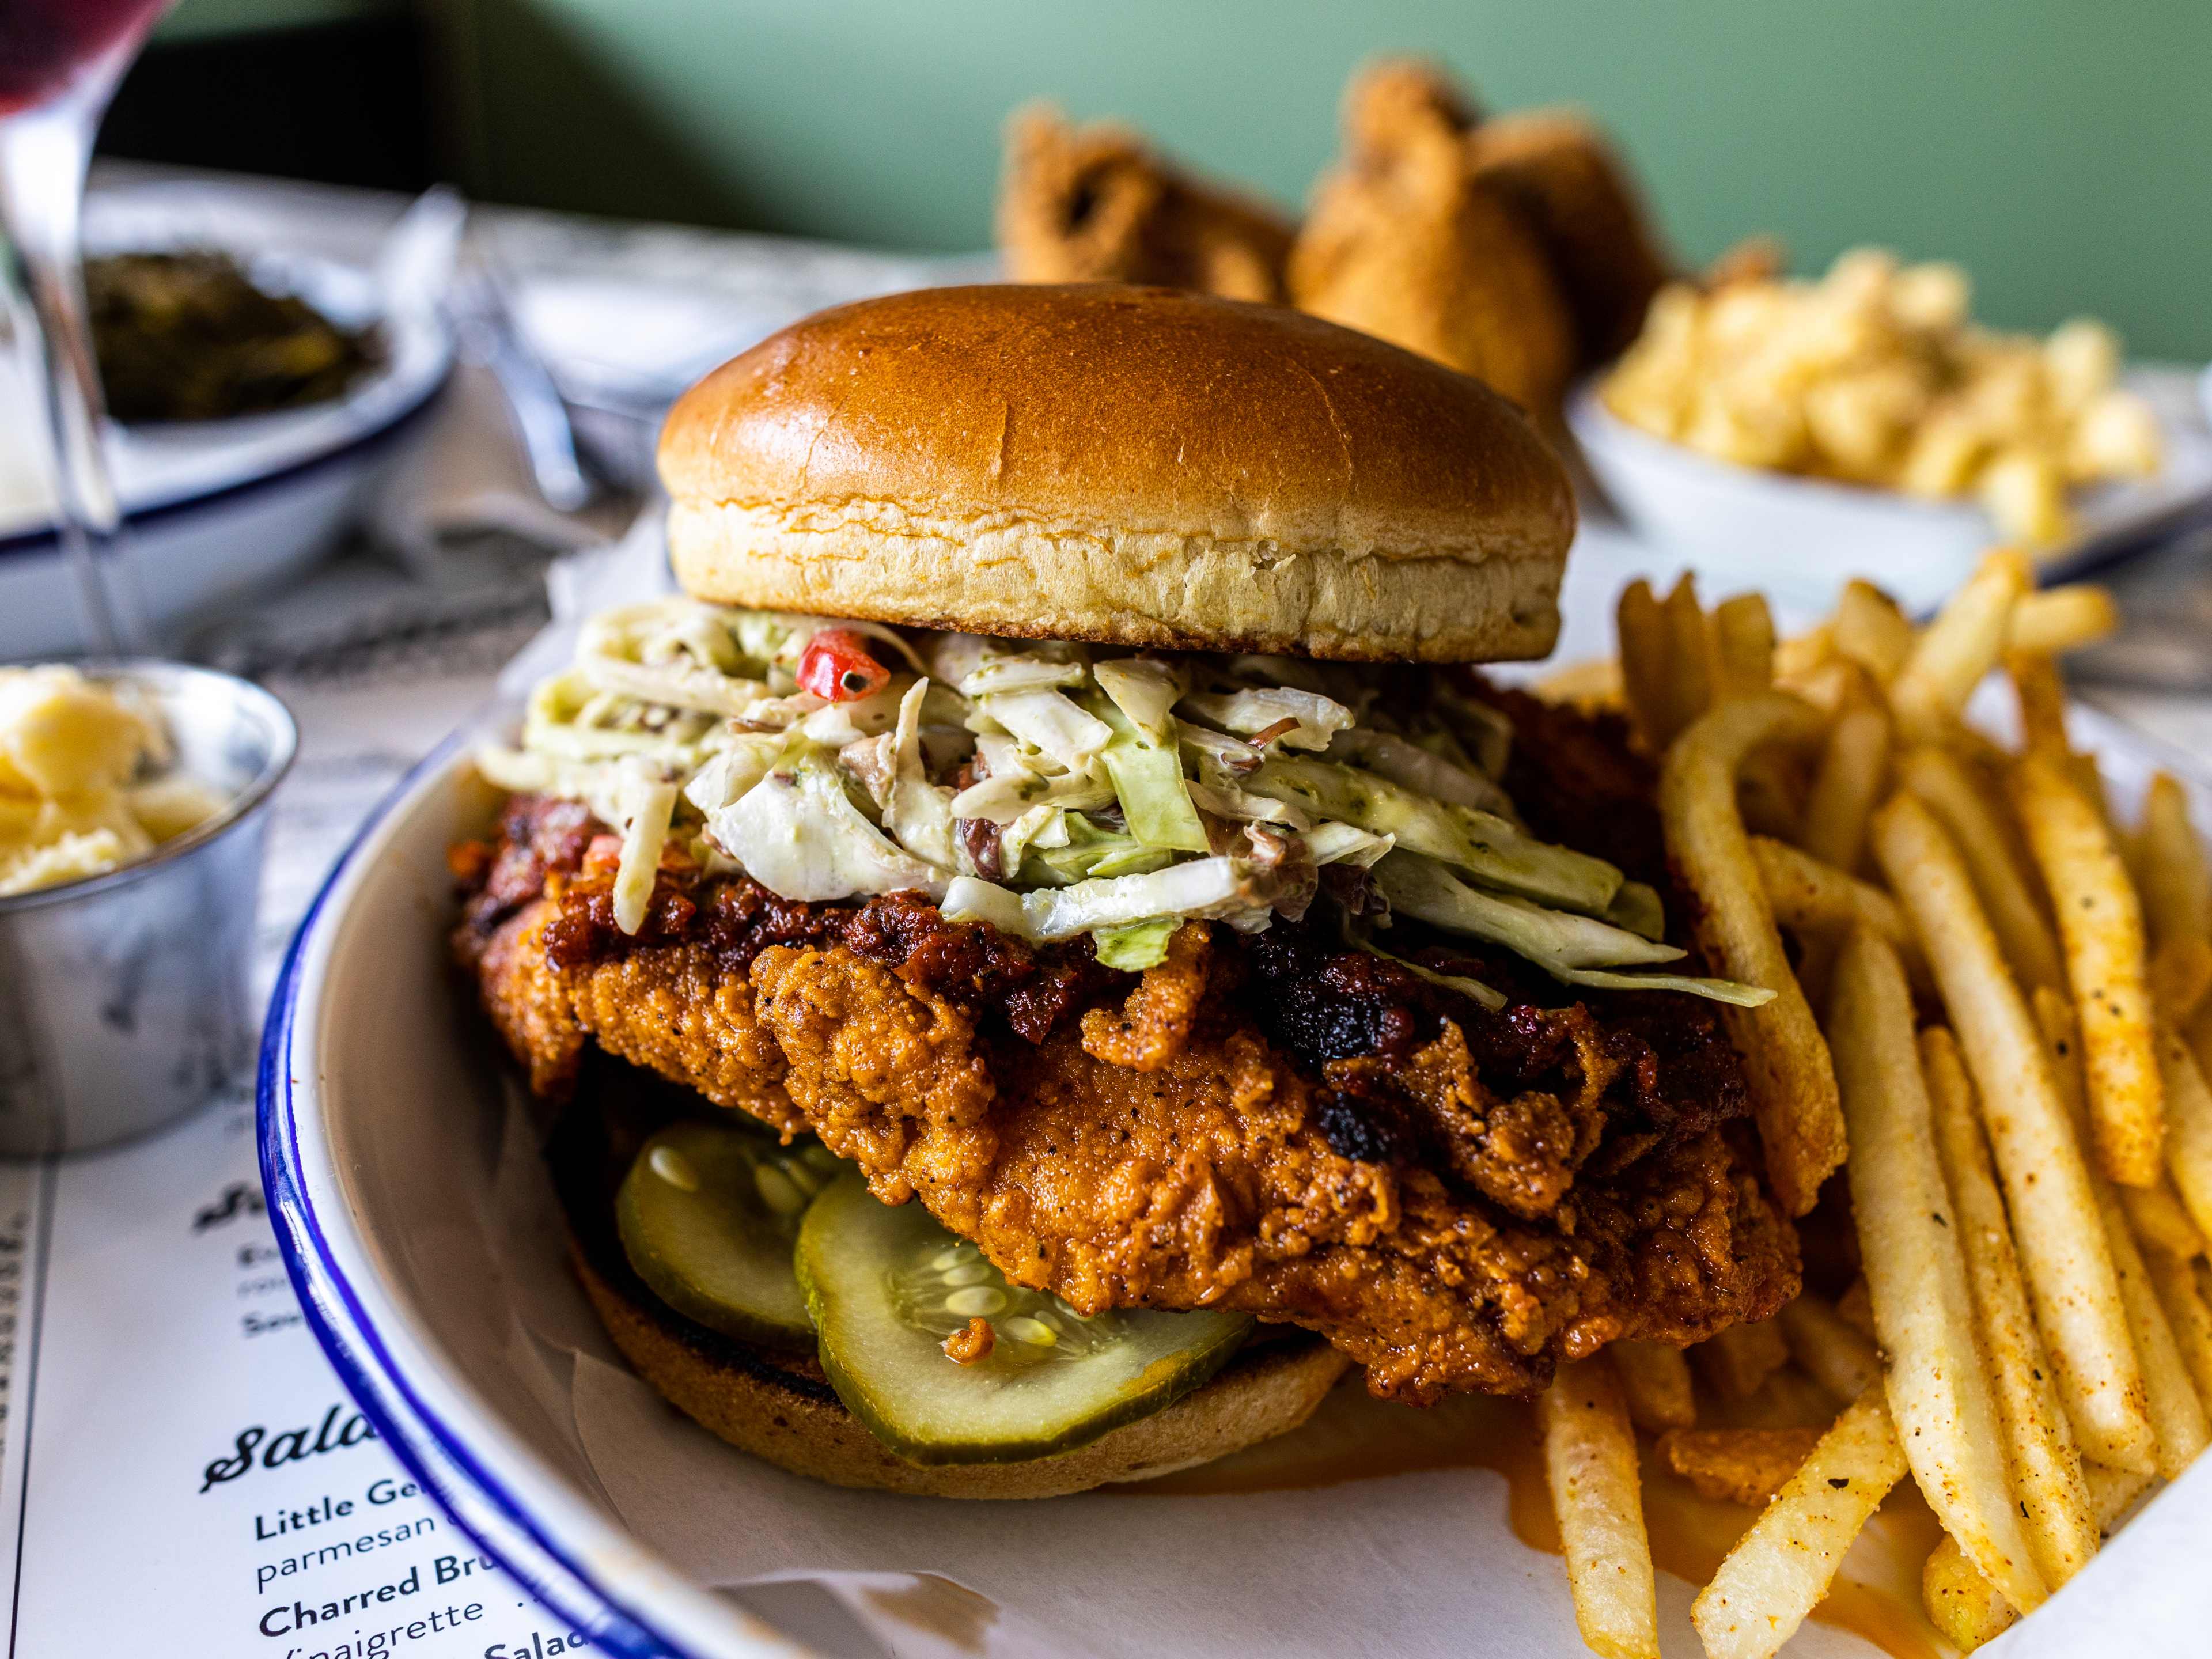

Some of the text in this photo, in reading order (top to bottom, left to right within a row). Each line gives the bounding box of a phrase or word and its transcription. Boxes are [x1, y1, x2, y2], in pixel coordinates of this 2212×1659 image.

[255, 1479, 426, 1540] Little Ge
[257, 1517, 435, 1594] parmesan
[260, 1566, 419, 1637] Charred
